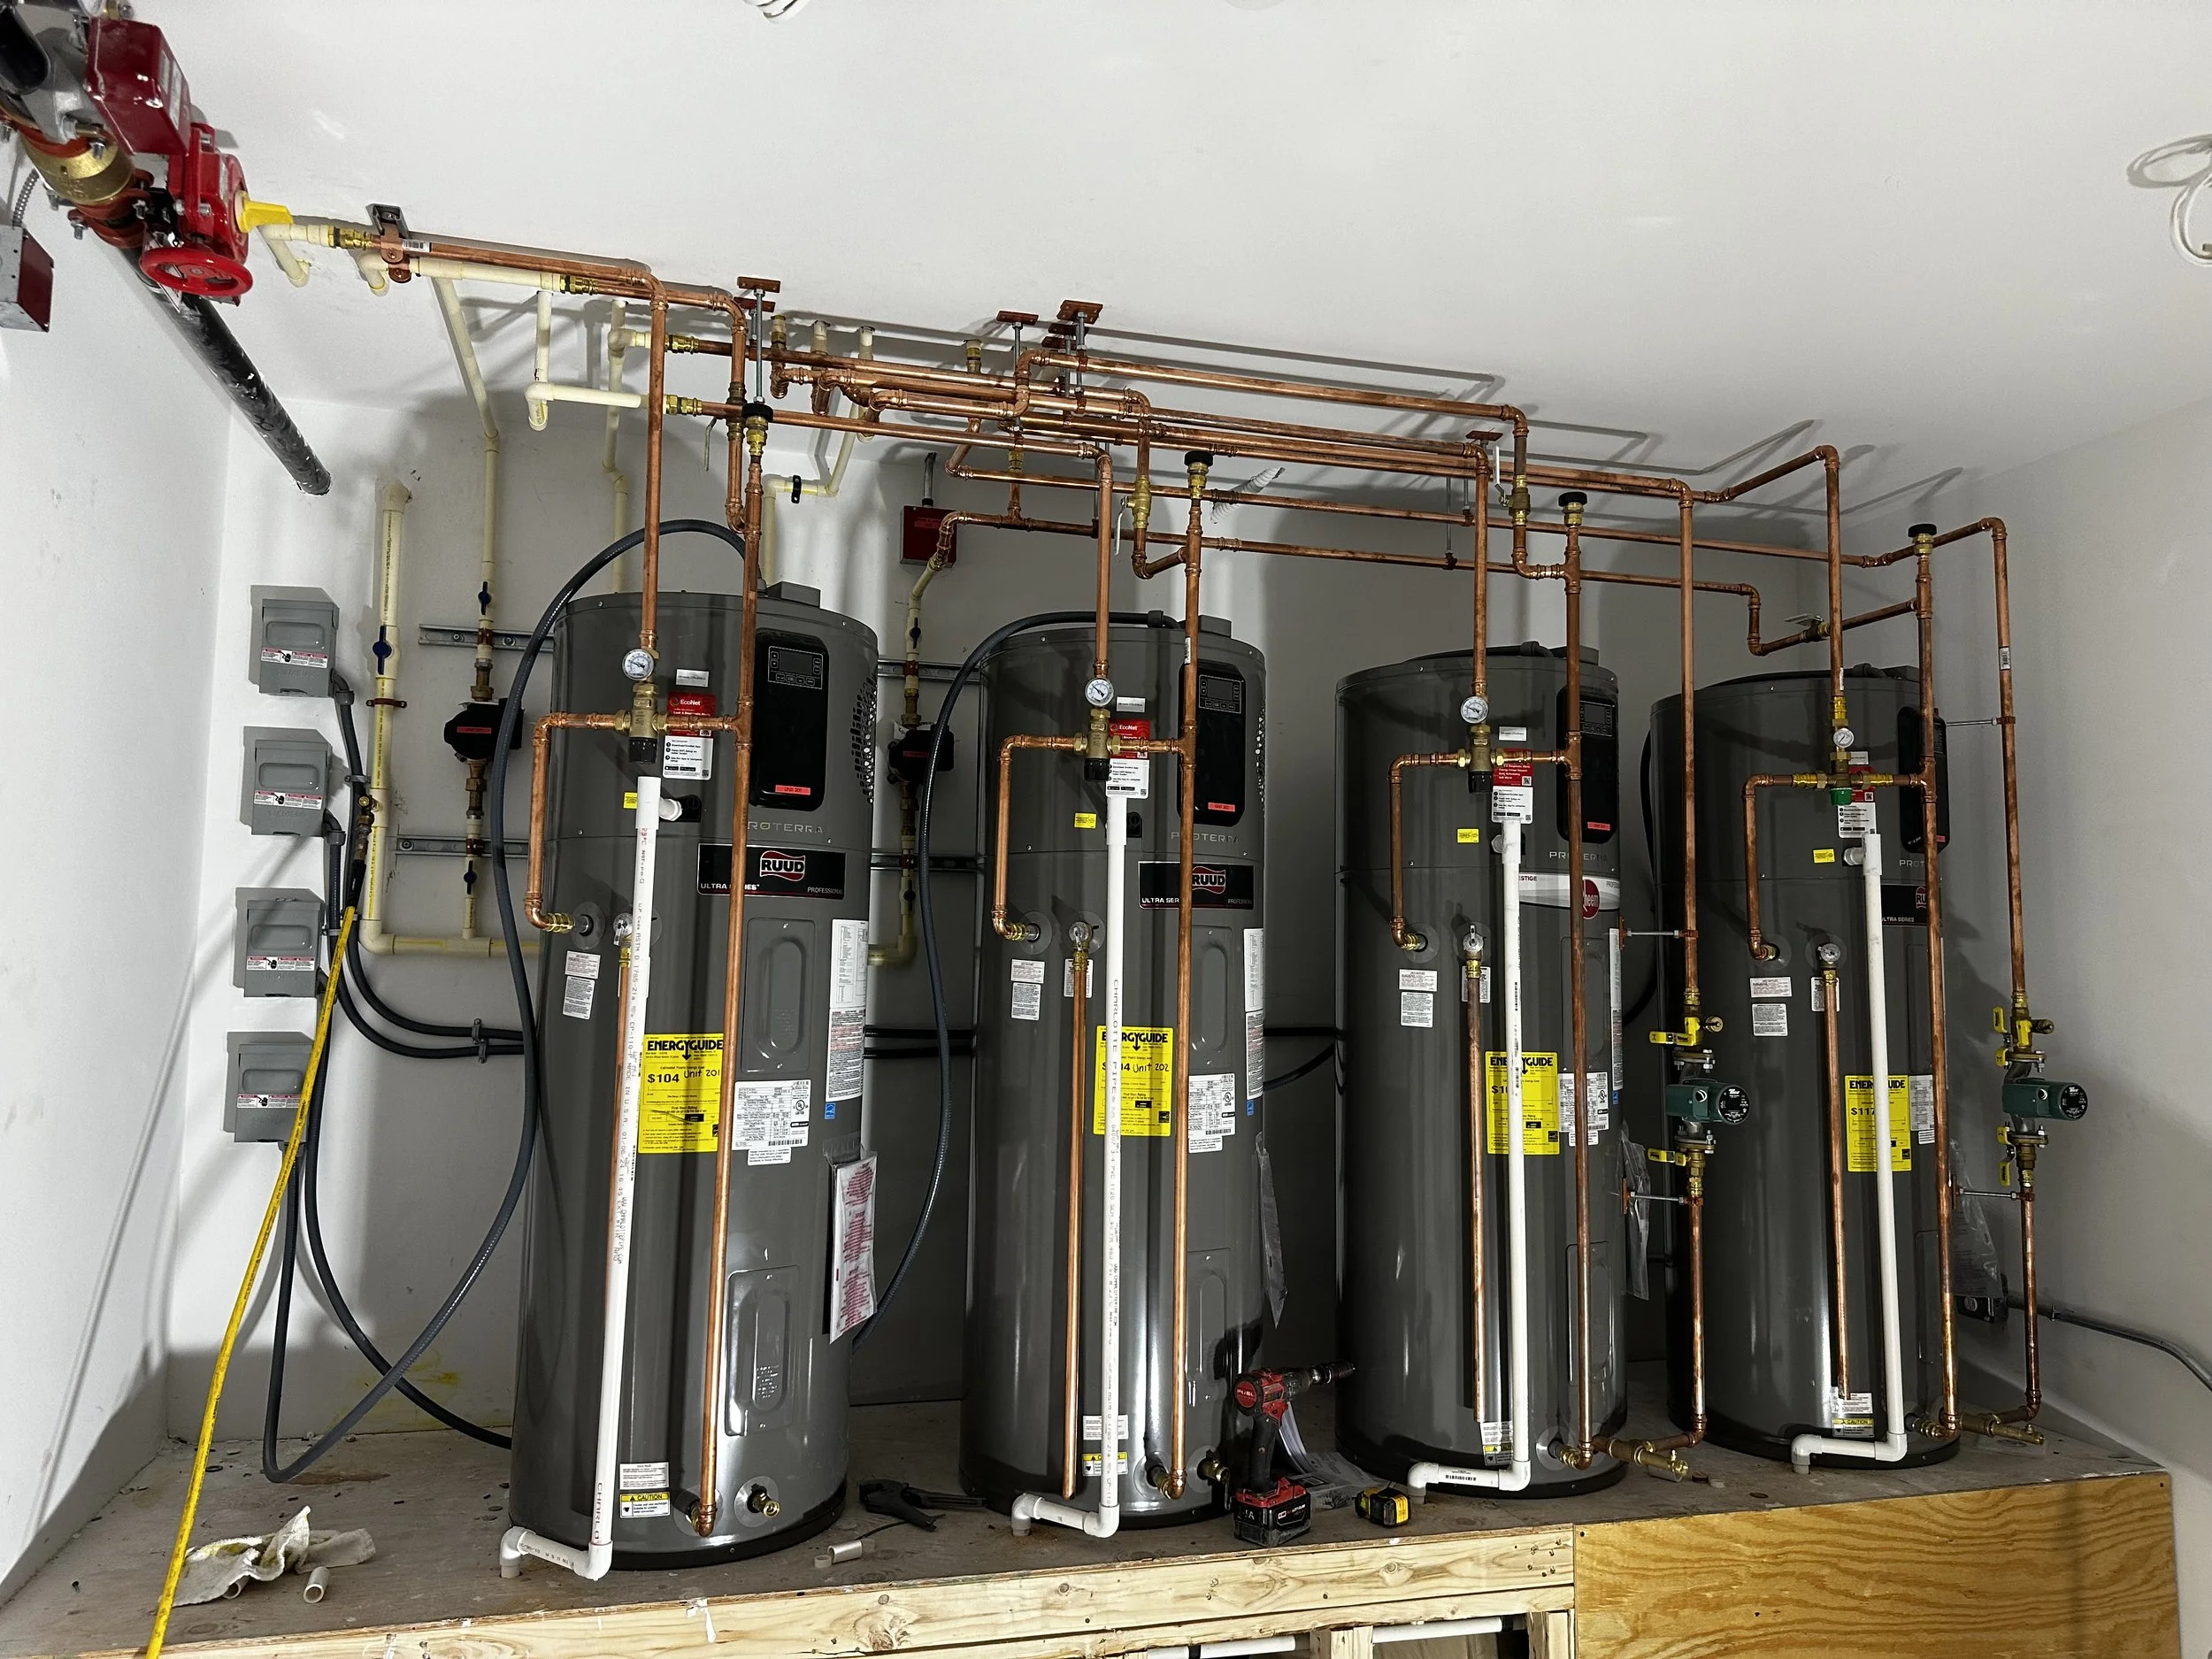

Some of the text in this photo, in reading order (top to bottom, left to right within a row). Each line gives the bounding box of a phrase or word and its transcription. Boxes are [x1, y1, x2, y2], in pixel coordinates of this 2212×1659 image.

[680, 697, 702, 706] EcoNet
[748, 821, 823, 833] ROTERRA
[1171, 832, 1239, 843] POTERRA
[1549, 851, 1607, 861] PRERRA
[761, 860, 804, 872] RUUD
[1899, 859, 1924, 868] PROT
[1192, 874, 1225, 886] RUUD
[1916, 895, 1926, 903] RU
[1102, 1032, 1168, 1043] ERGYGUIDE
[648, 1040, 724, 1052] ENERGYGUIDE
[1490, 1057, 1553, 1066] ENEYGUIDE
[1133, 1064, 1170, 1073] Unit 202
[647, 1073, 680, 1084] $104
[684, 1069, 703, 1079] Unit
[1849, 1079, 1906, 1089] ENERUIDE
[625, 1087, 631, 1095] IN
[594, 1482, 603, 1540] CHARLO
